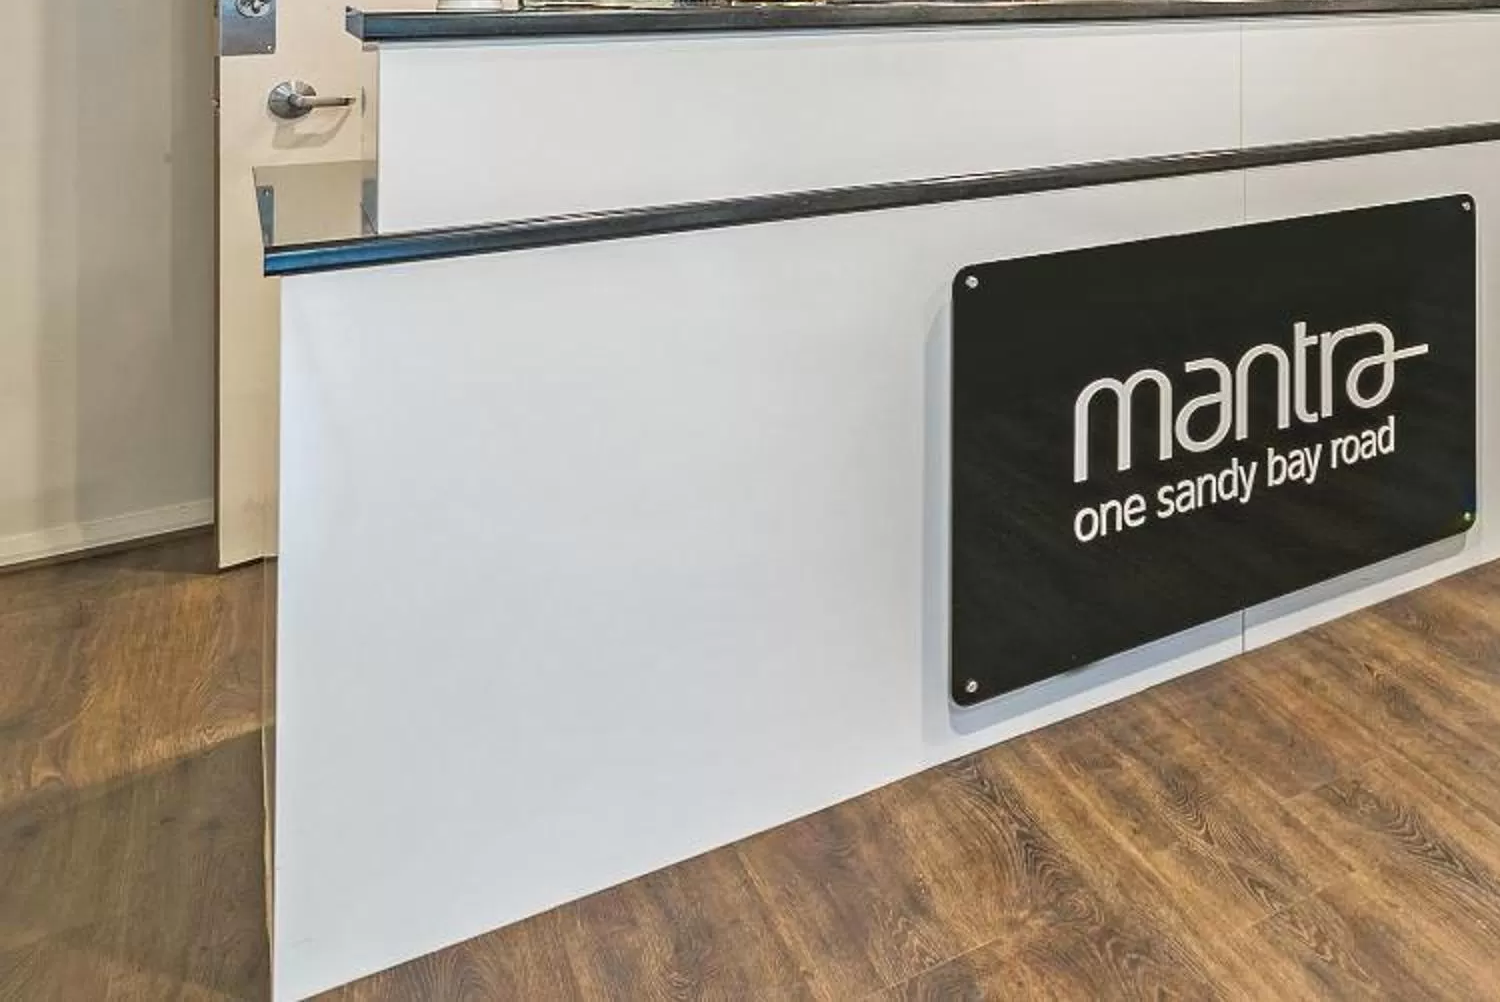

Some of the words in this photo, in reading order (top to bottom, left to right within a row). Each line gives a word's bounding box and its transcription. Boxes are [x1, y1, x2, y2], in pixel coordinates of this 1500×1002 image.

[1074, 321, 1429, 484] mantra
[1074, 491, 1147, 543] one
[1157, 456, 1258, 520] sandy
[1268, 442, 1324, 488] bay
[1330, 416, 1396, 470] road
